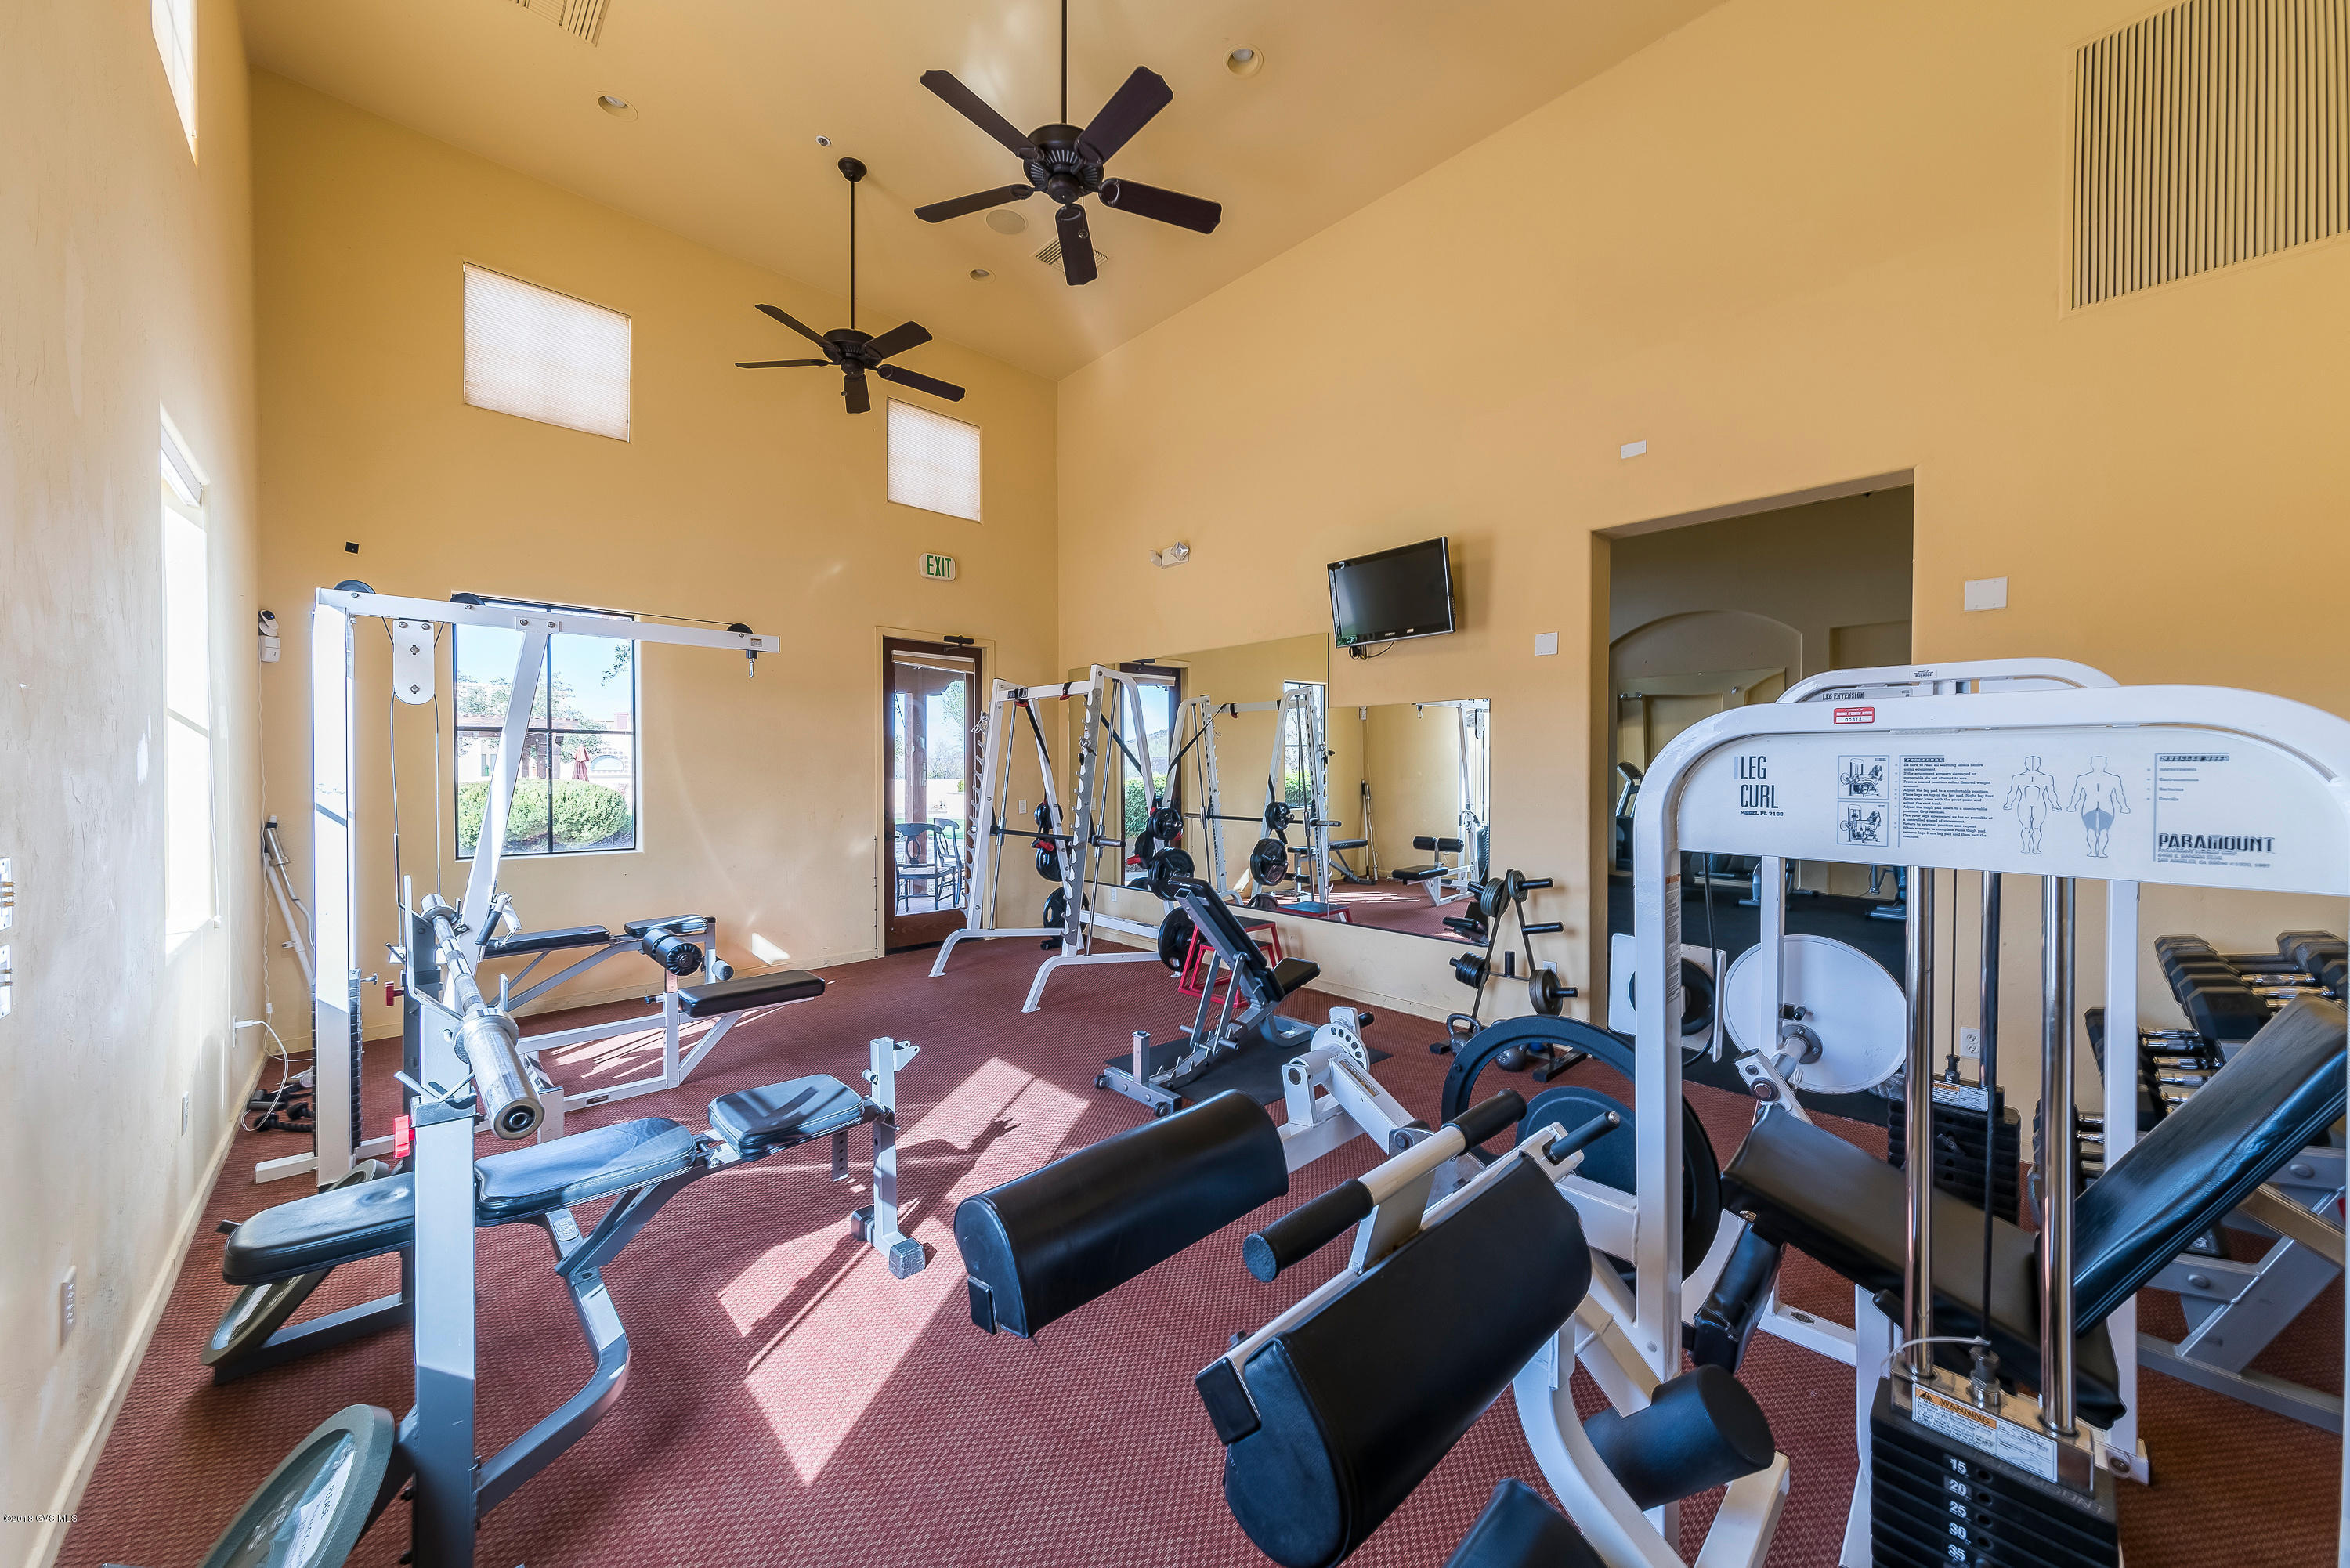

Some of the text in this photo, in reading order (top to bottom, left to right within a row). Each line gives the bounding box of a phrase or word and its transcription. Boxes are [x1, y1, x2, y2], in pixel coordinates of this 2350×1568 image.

[927, 555, 951, 578] EXIT
[1822, 692, 1864, 701] LEG EXTENSION
[1740, 755, 1767, 780] LEG
[1741, 784, 1779, 809] CURL
[2158, 833, 2275, 852] PARAMOUNT
[1940, 1398, 1990, 1425] WARNING
[1949, 1458, 1967, 1475] 15
[1949, 1479, 1967, 1497] 20
[320, 1484, 335, 1520] PLEASE
[1949, 1501, 1967, 1518] 25
[1948, 1544, 1966, 1562] 35
